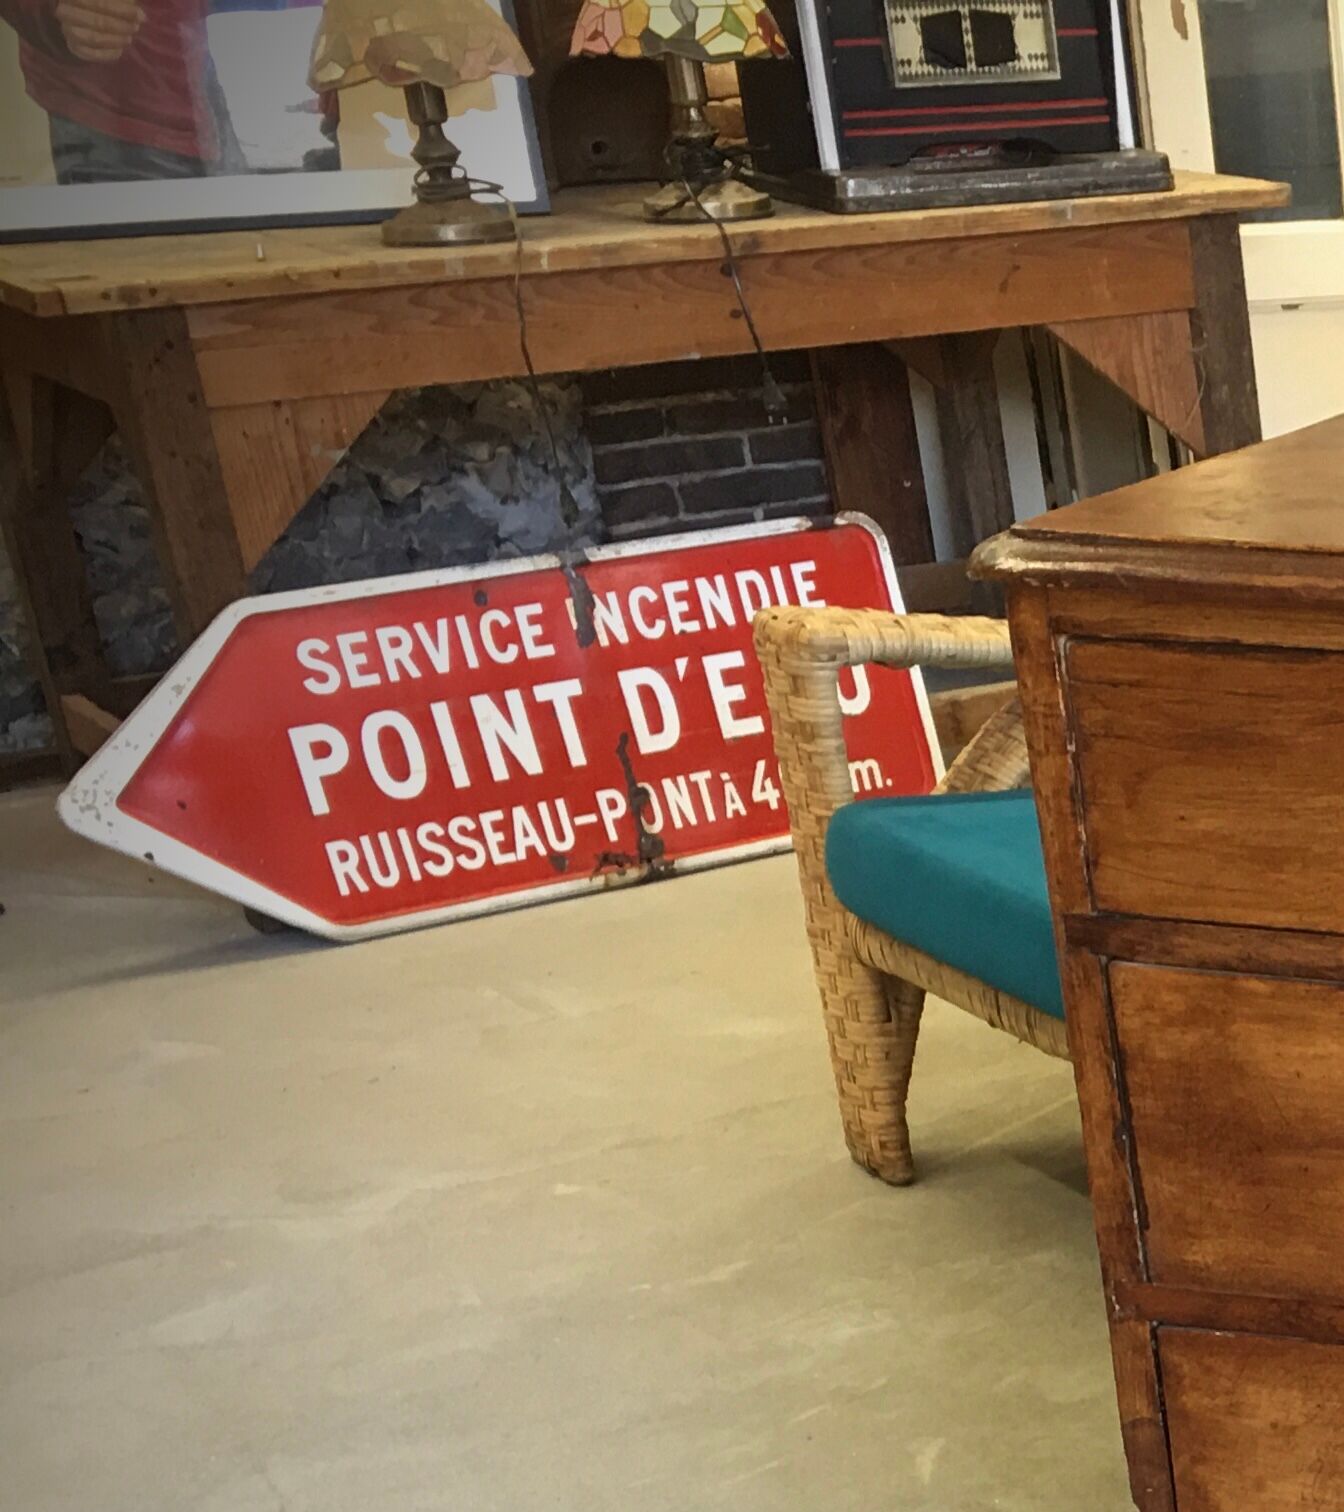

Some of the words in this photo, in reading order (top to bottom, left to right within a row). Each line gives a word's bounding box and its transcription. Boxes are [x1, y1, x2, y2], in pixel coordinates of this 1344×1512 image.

[296, 602, 556, 695] SERVICE
[287, 678, 588, 816] POINT
[616, 650, 871, 755] D'EU
